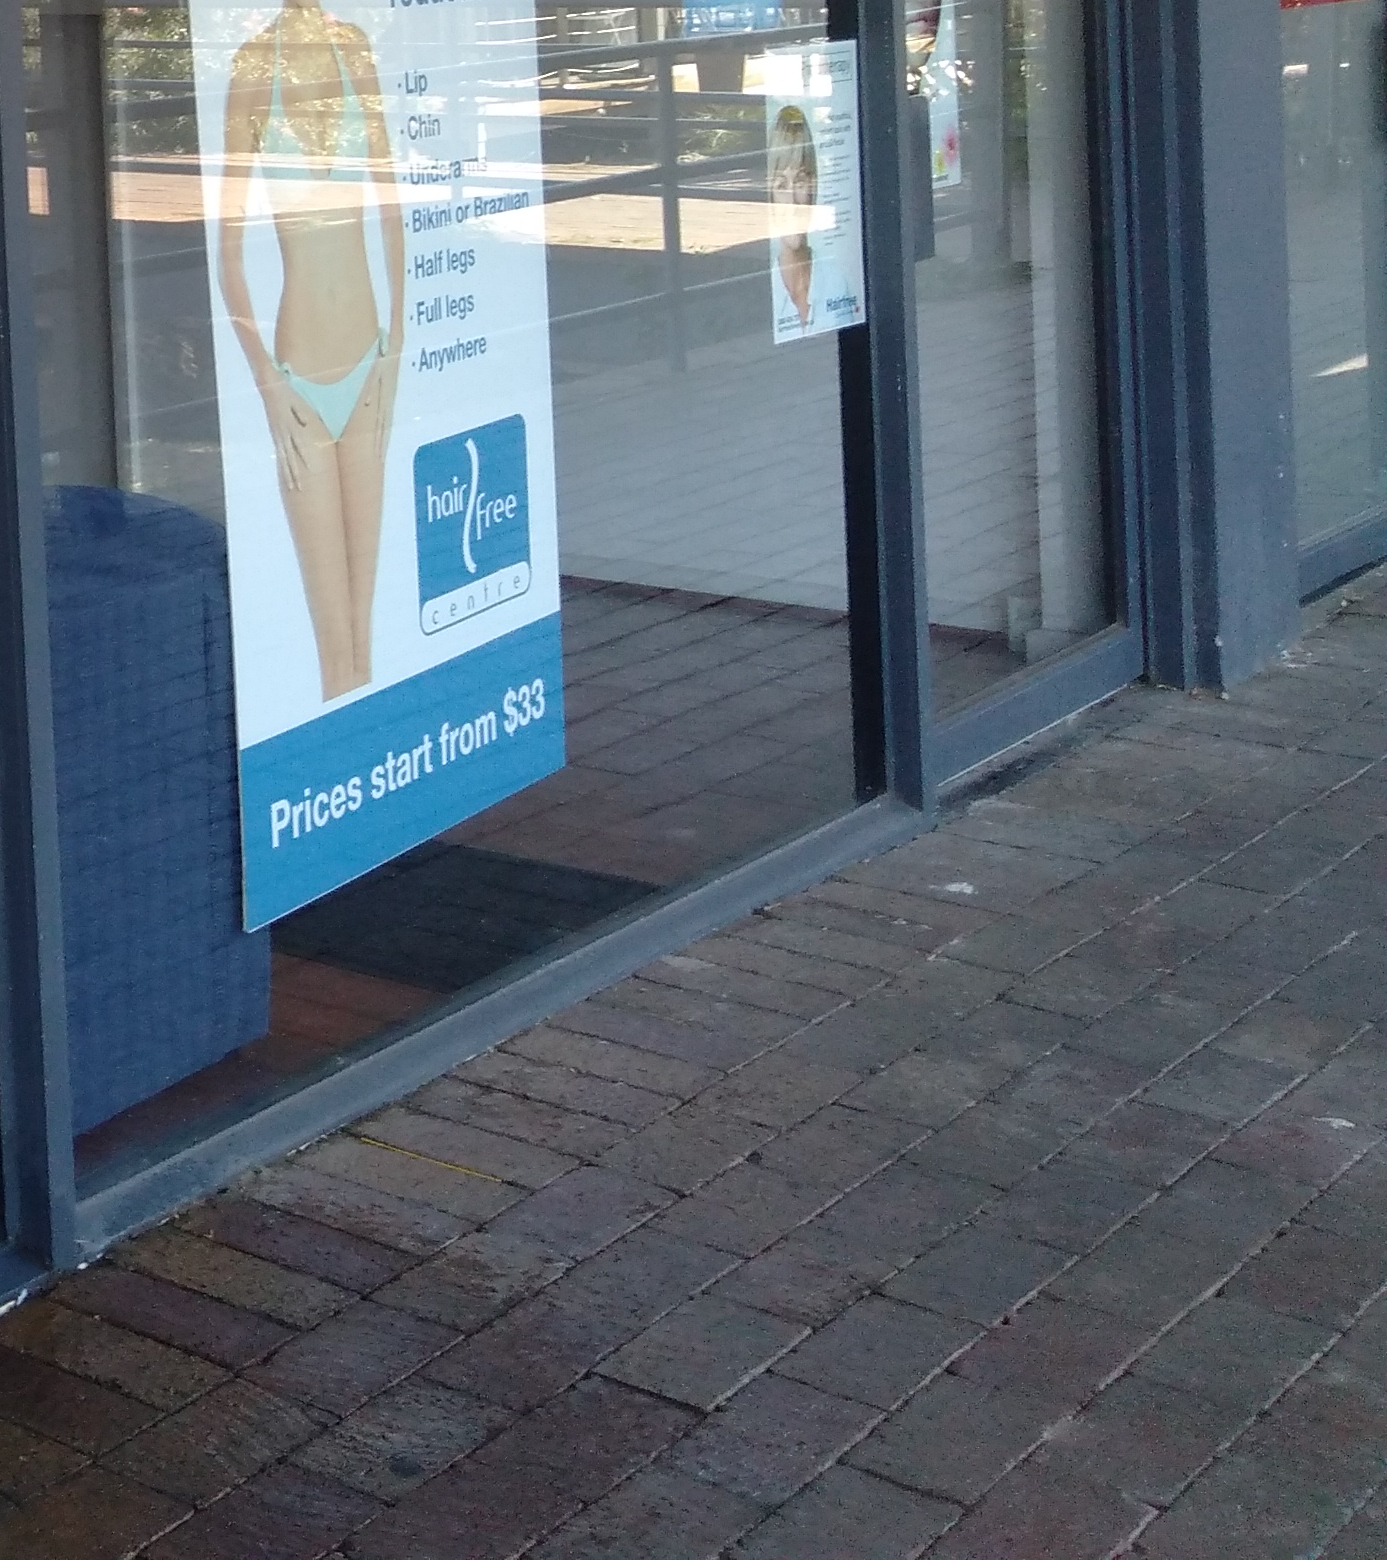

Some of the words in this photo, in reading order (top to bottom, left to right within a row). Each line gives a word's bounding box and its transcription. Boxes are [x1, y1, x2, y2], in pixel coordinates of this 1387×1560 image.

[405, 70, 428, 96] Lip
[407, 113, 441, 140] Chin
[412, 203, 452, 233] Bikini
[456, 204, 470, 223] or
[474, 191, 530, 218] Brazilian
[414, 250, 443, 279] Half
[446, 248, 476, 274] legs
[416, 297, 443, 326] Full
[446, 294, 475, 320] legs
[418, 337, 488, 372] Anywhere
[427, 476, 467, 523] hair
[475, 493, 517, 541] free
[431, 573, 521, 626] centre
[270, 775, 363, 849] Prices
[371, 733, 434, 799] start
[438, 711, 498, 766] from
[502, 678, 546, 737] $33
